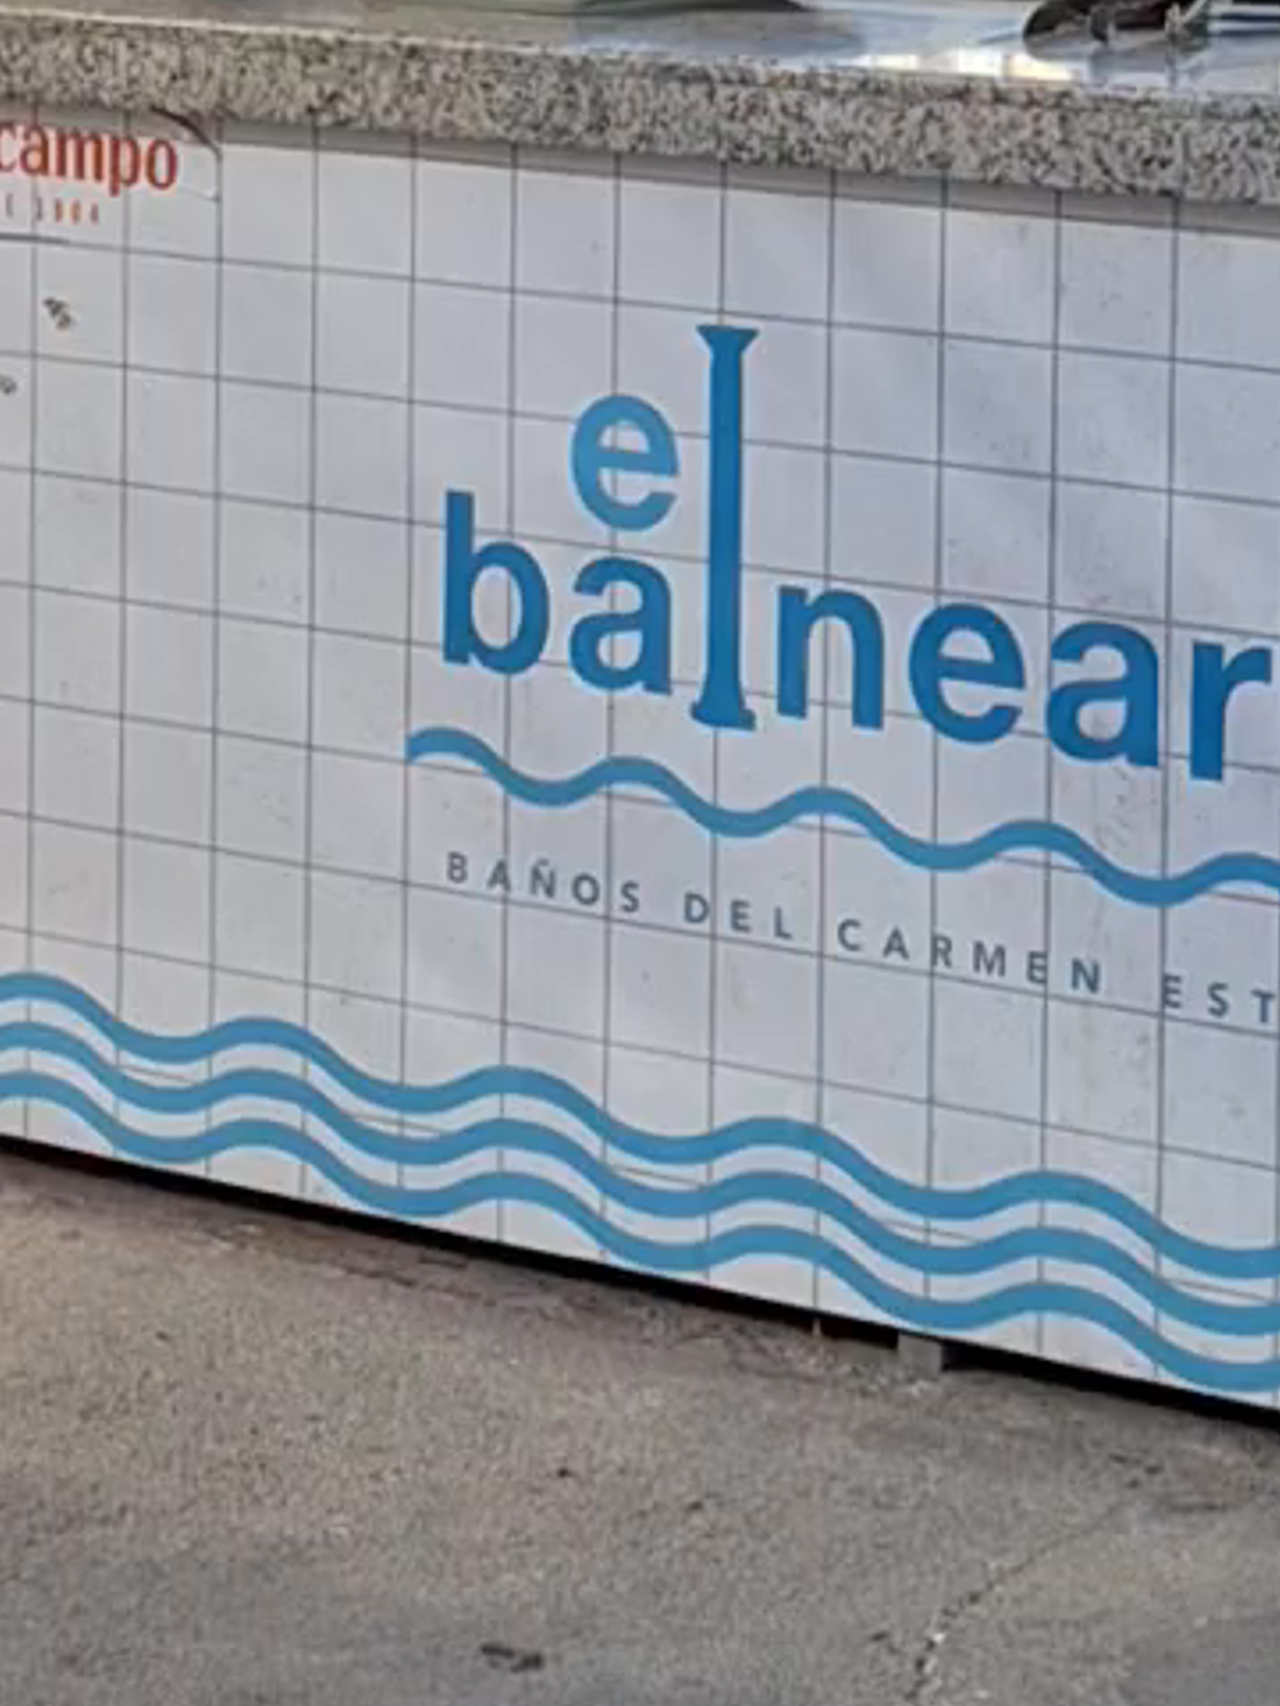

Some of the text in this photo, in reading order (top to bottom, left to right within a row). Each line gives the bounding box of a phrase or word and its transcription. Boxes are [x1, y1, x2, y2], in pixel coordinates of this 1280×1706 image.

[571, 325, 758, 730] el
[447, 852, 640, 914] BAÑOS
[684, 893, 793, 940] DEL
[837, 918, 1101, 994] CARMEN
